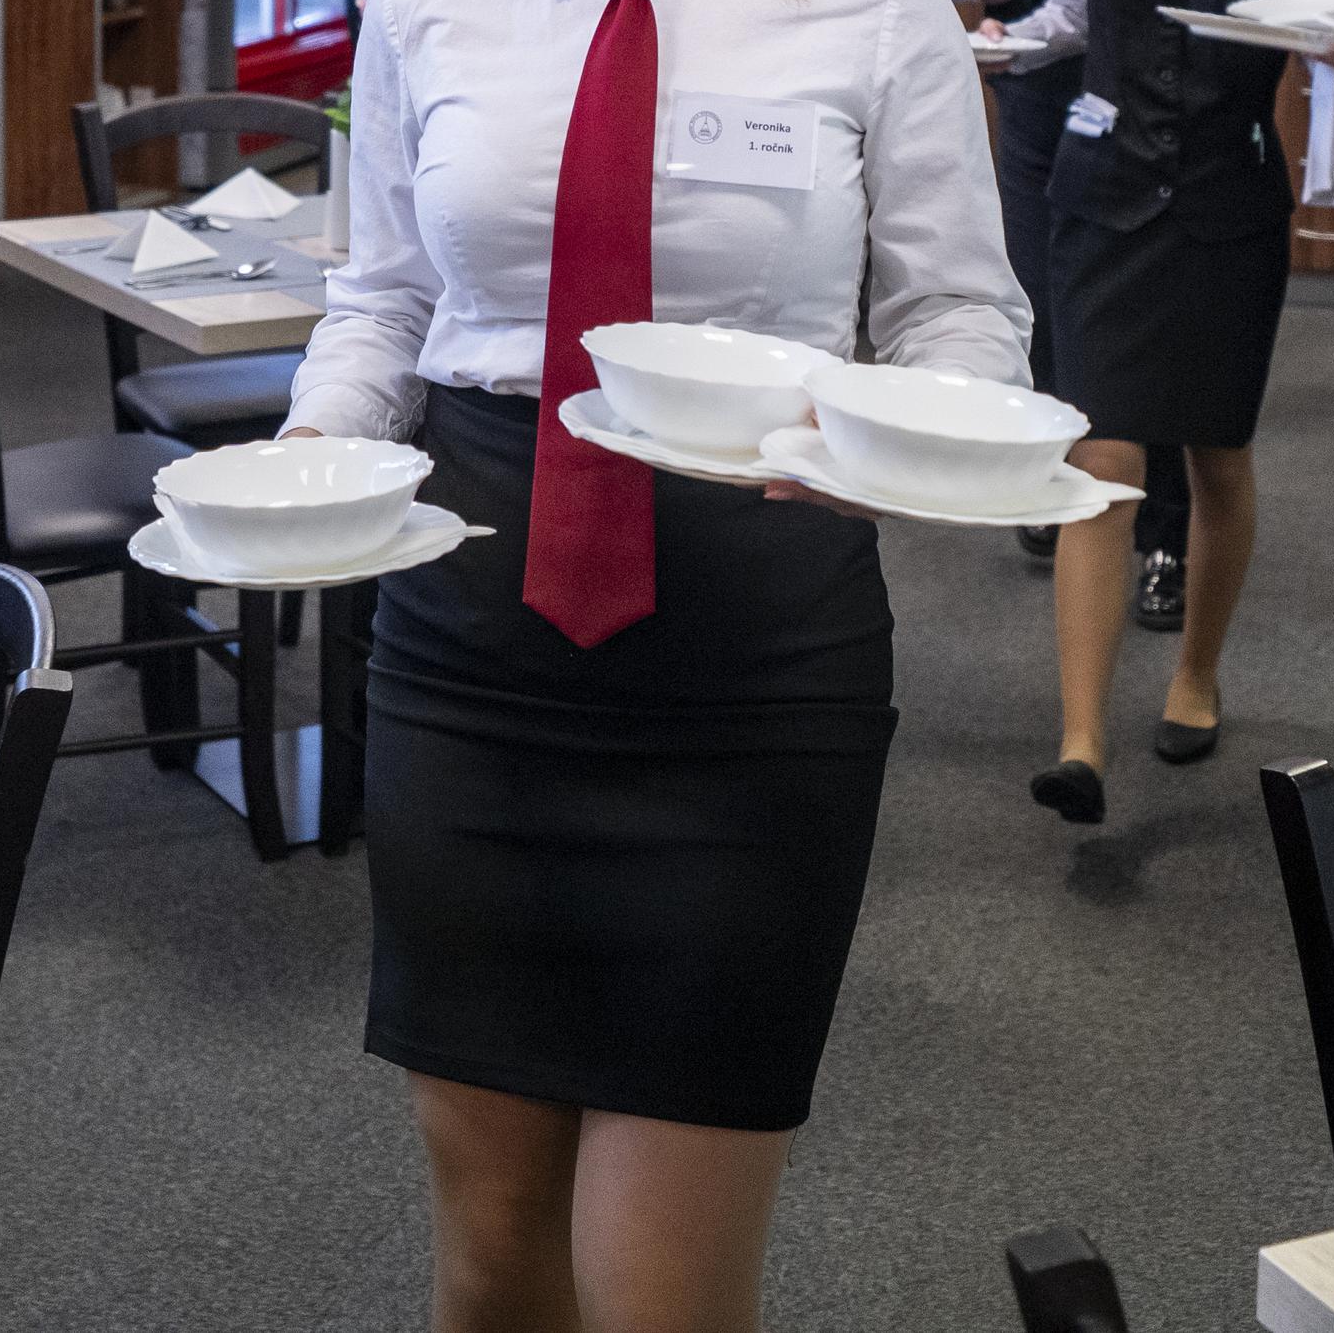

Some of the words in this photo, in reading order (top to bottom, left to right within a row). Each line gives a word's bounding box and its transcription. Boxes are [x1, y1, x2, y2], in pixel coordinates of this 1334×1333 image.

[745, 120, 791, 133] Veronika
[749, 141, 759, 151] 1.
[761, 142, 793, 153] ročník
